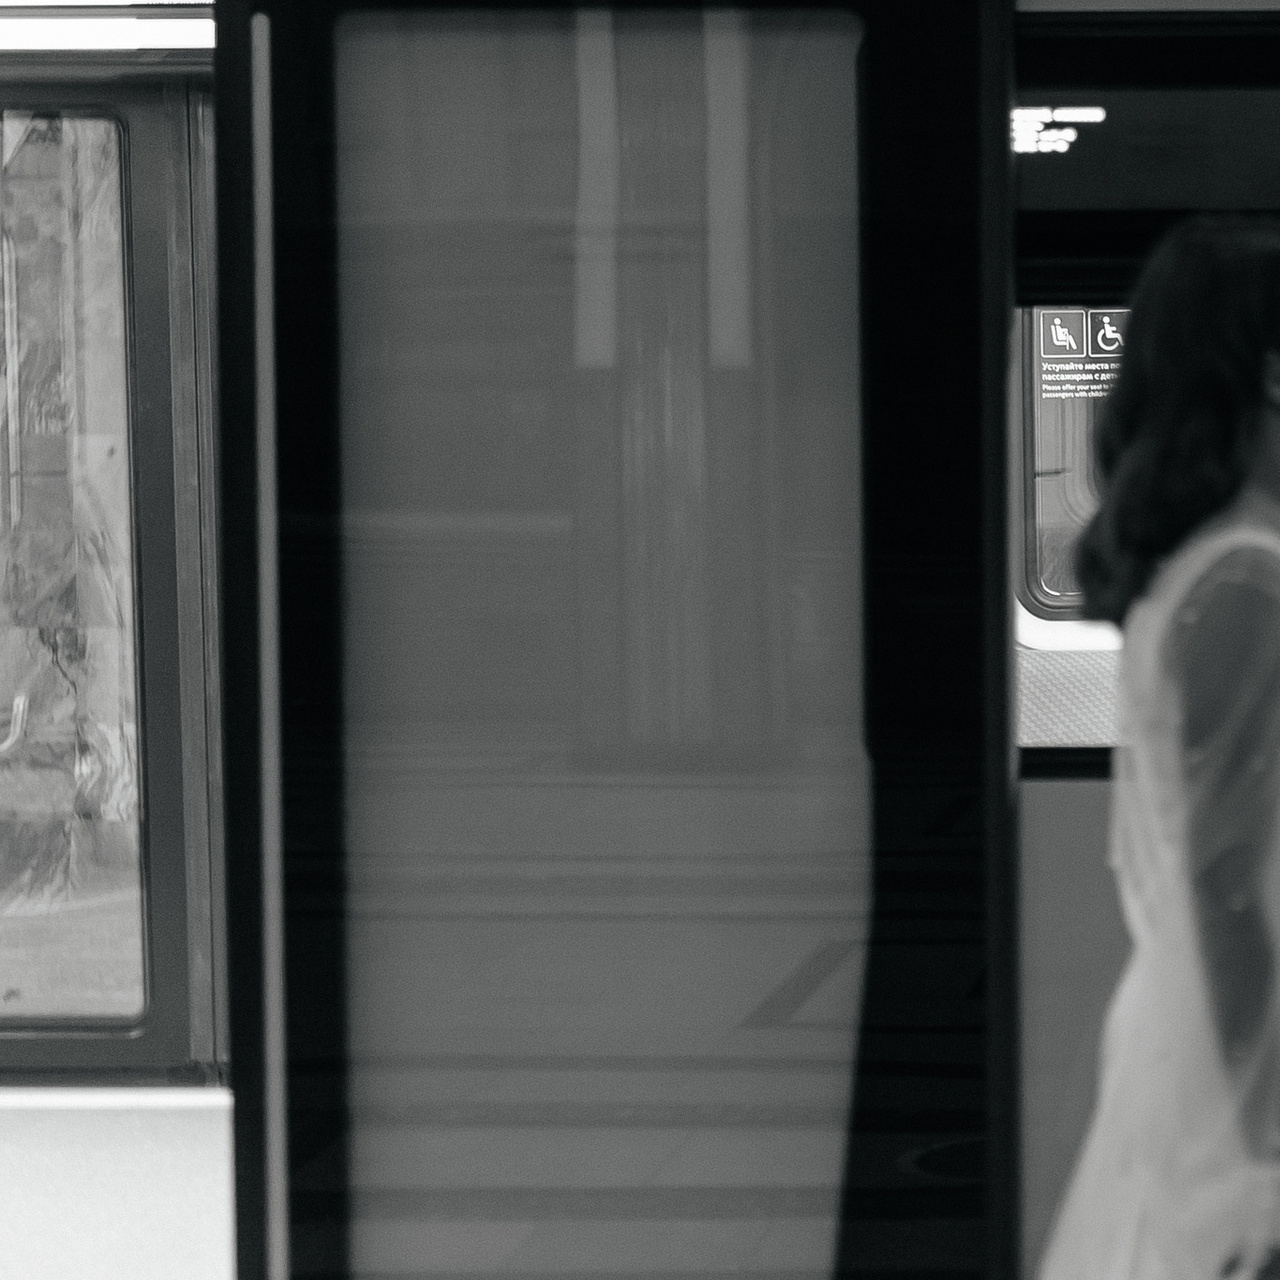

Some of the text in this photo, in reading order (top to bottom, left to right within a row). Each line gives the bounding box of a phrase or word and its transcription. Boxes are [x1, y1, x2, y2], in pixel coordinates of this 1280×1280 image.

[1042, 362, 1083, 372] Уступайте
[1042, 373, 1093, 381] пассажирам
[1042, 383, 1061, 391] Please
